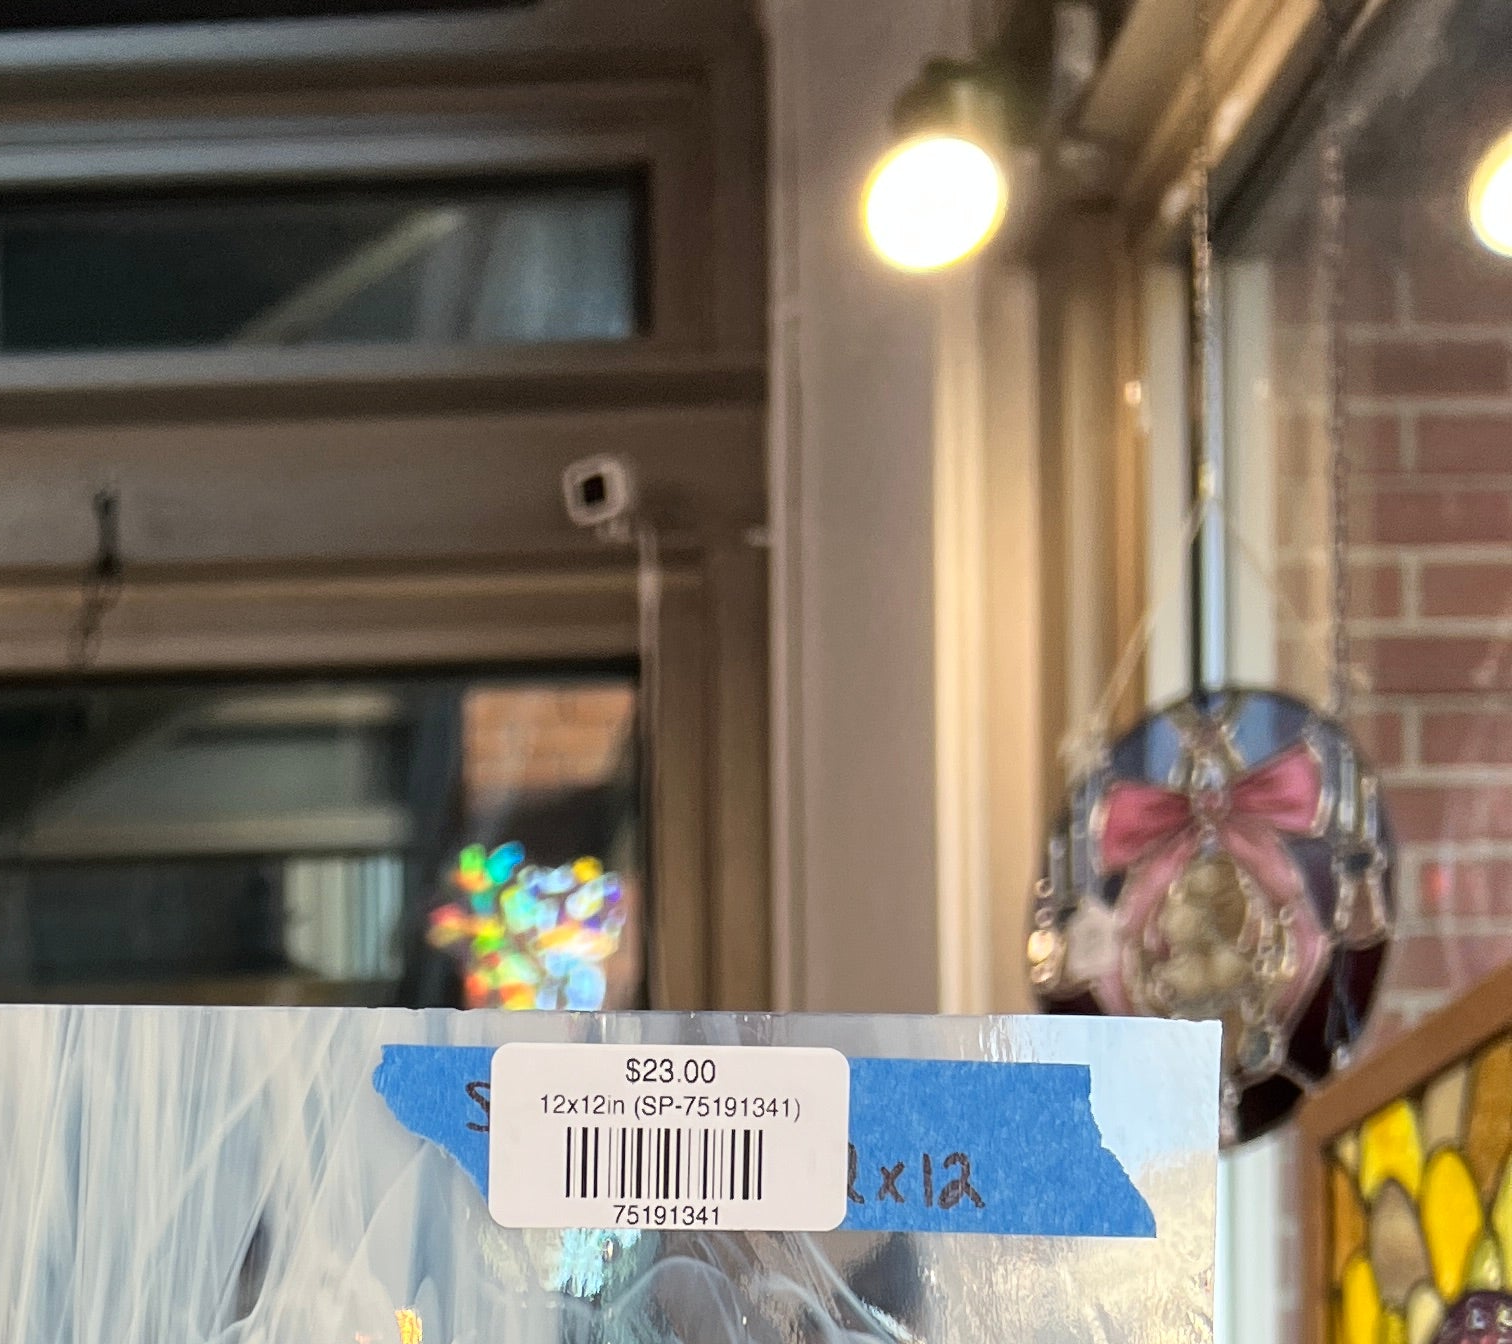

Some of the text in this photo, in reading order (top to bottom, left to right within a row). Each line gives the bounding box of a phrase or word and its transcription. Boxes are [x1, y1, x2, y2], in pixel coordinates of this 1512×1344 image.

[625, 1057, 717, 1084] $23.00
[540, 1093, 802, 1123] 12x12in (SP-75191341)
[612, 1203, 720, 1227] 75191341
